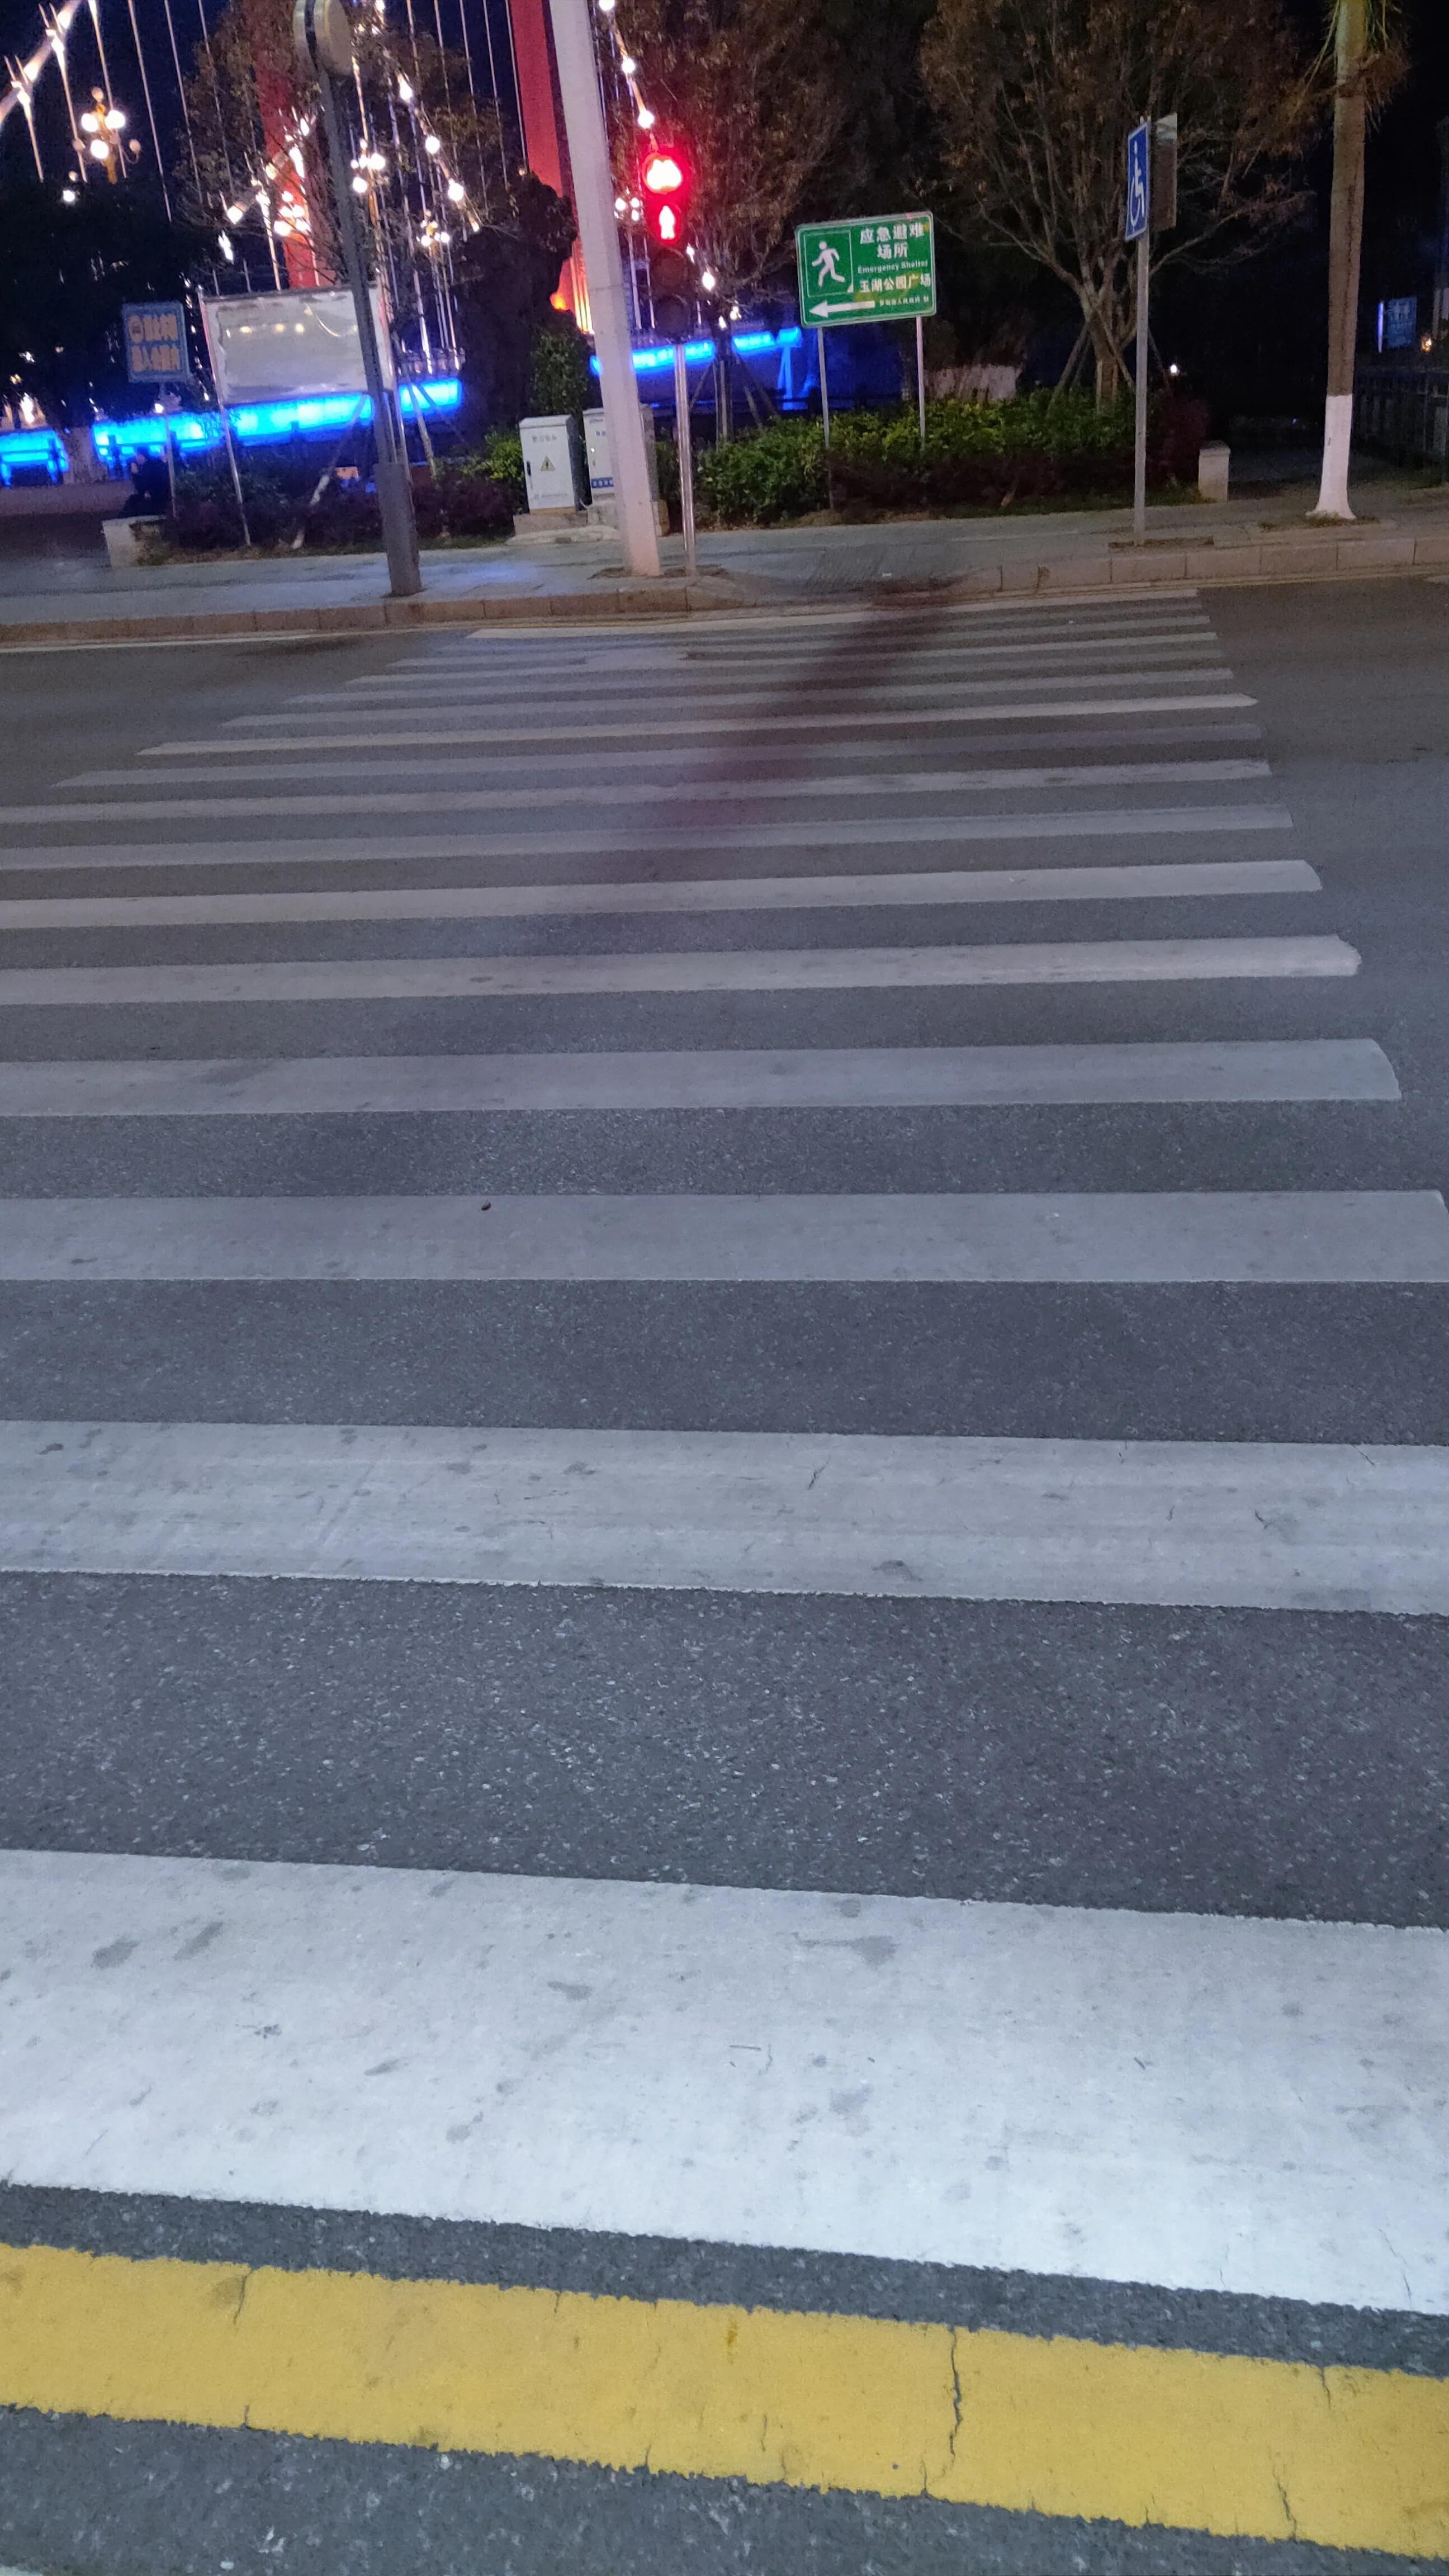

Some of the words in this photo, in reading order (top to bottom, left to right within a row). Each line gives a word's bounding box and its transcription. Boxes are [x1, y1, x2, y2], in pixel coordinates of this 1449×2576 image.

[860, 222, 924, 244] 应急避难
[878, 242, 908, 259] 场所
[858, 263, 899, 273] Emergency
[901, 259, 928, 269] Shelter
